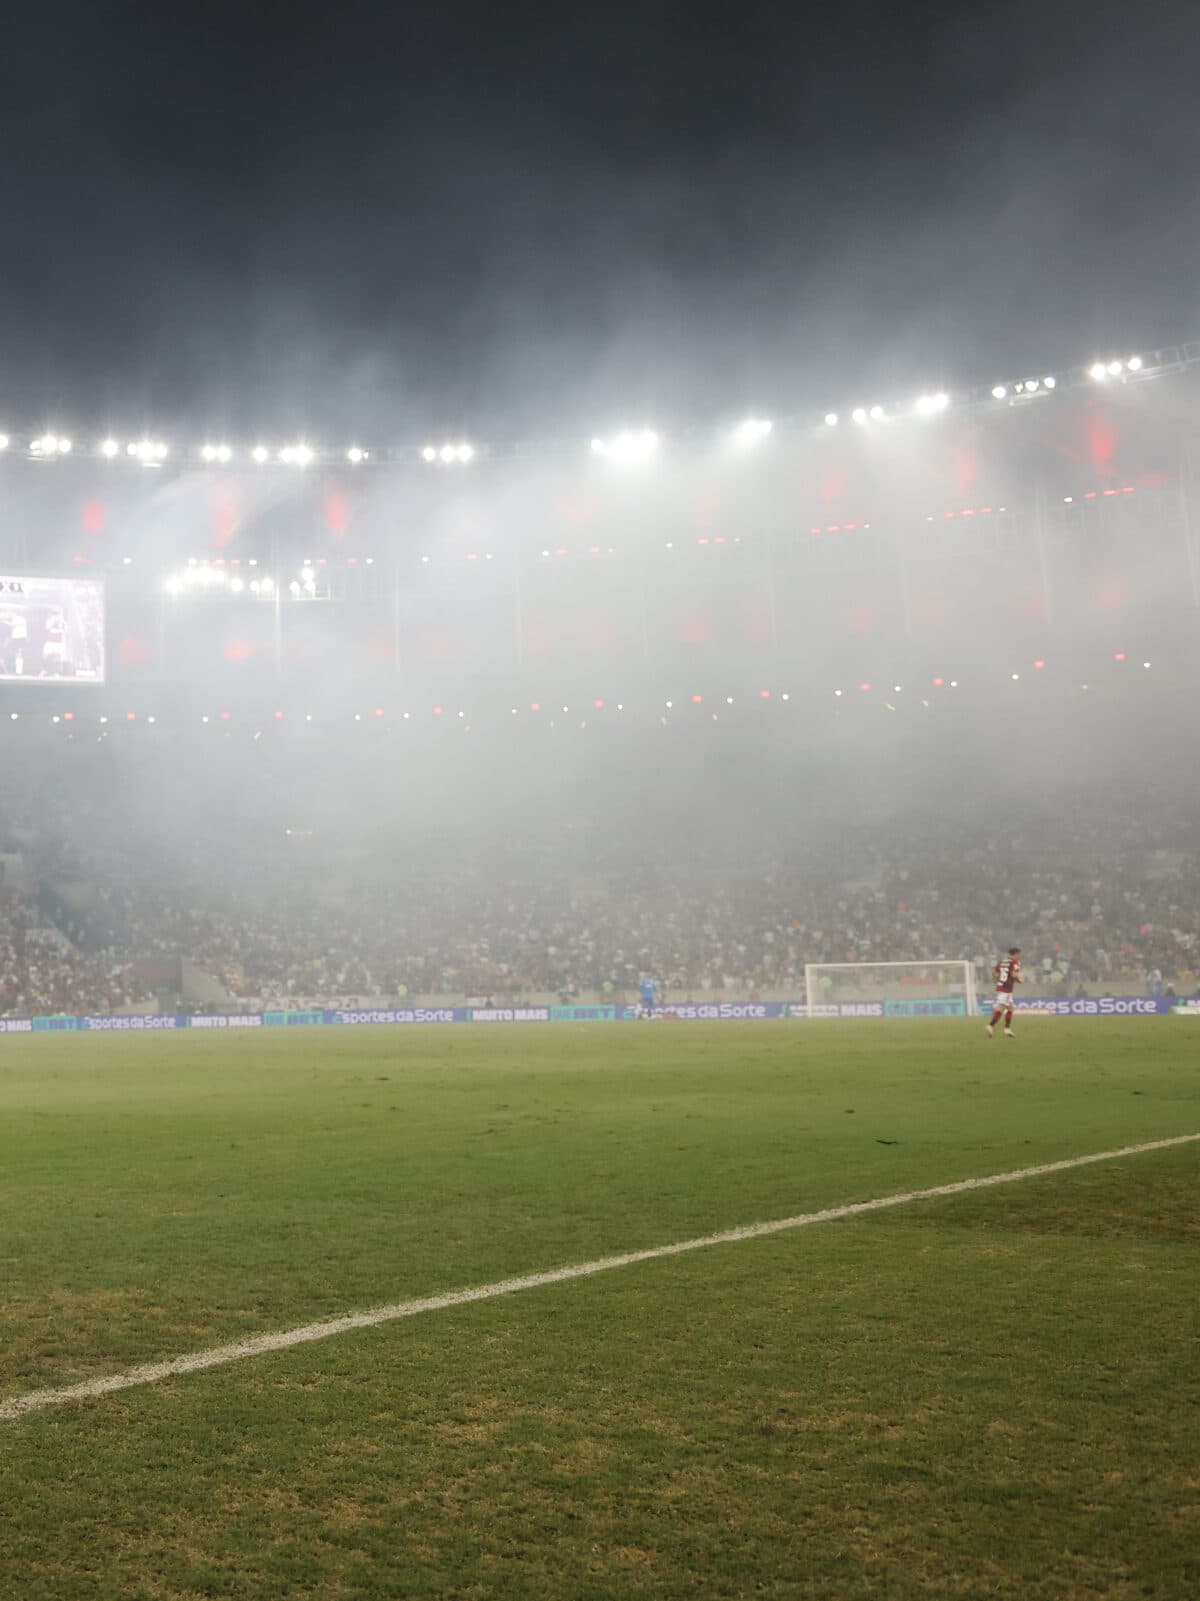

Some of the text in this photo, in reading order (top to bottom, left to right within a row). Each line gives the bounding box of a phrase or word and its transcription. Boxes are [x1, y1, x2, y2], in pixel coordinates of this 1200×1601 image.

[698, 1004, 718, 1018] da
[720, 1003, 766, 1018] Sorte
[841, 1003, 883, 1016] MAIS
[1072, 999, 1098, 1013] da
[1099, 998, 1157, 1013] Sorte
[144, 1015, 176, 1028] Sorte
[333, 1010, 395, 1024] Esportes
[396, 1010, 414, 1023] da
[415, 1009, 453, 1022] Sorte
[472, 1009, 513, 1021] MUITO
[514, 1008, 549, 1020] MAIS
